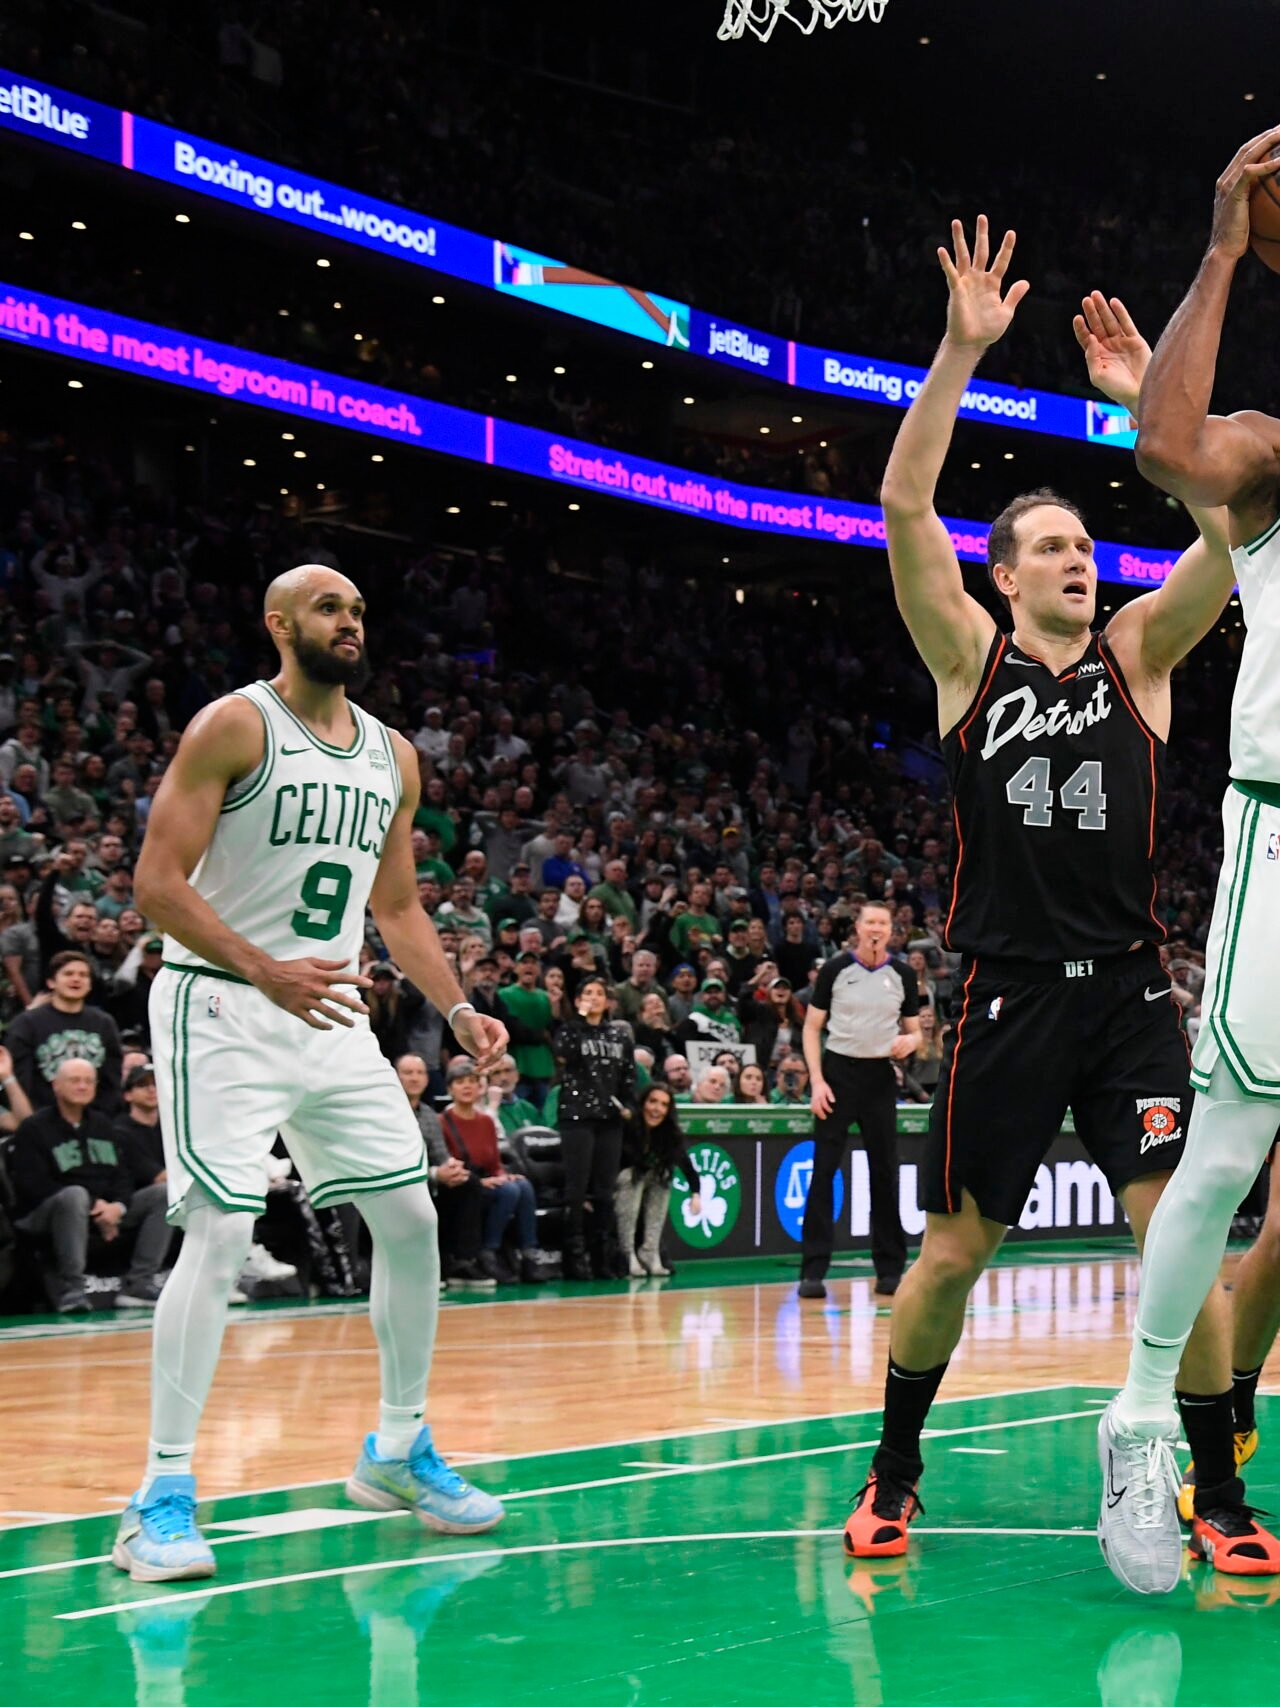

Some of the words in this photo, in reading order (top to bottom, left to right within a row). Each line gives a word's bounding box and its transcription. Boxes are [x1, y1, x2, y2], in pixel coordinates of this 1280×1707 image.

[174, 140, 273, 208] Boxing
[276, 184, 436, 256] out...woooo!
[54, 313, 108, 352] the
[113, 334, 190, 375] most
[193, 348, 307, 406] legroom
[310, 380, 335, 413] in
[338, 395, 422, 435] coach.
[708, 323, 769, 366] jetBlue
[823, 358, 902, 401] Boxing
[549, 444, 629, 488] Stretch
[632, 472, 666, 499] out
[669, 480, 713, 510] with
[714, 490, 748, 519] the
[751, 502, 812, 529] most
[816, 506, 887, 540] legroo
[949, 533, 988, 554] oac
[1120, 553, 1174, 580] Stret
[980, 679, 1112, 761] Detroit
[269, 782, 391, 860] CELTICS
[1006, 756, 1106, 830] 44
[291, 860, 353, 941] 9
[1063, 959, 1094, 978] DET
[1135, 1097, 1181, 1115] PISTONS
[673, 1148, 737, 1192] CLTICS
[1140, 1126, 1182, 1155] Detroit
